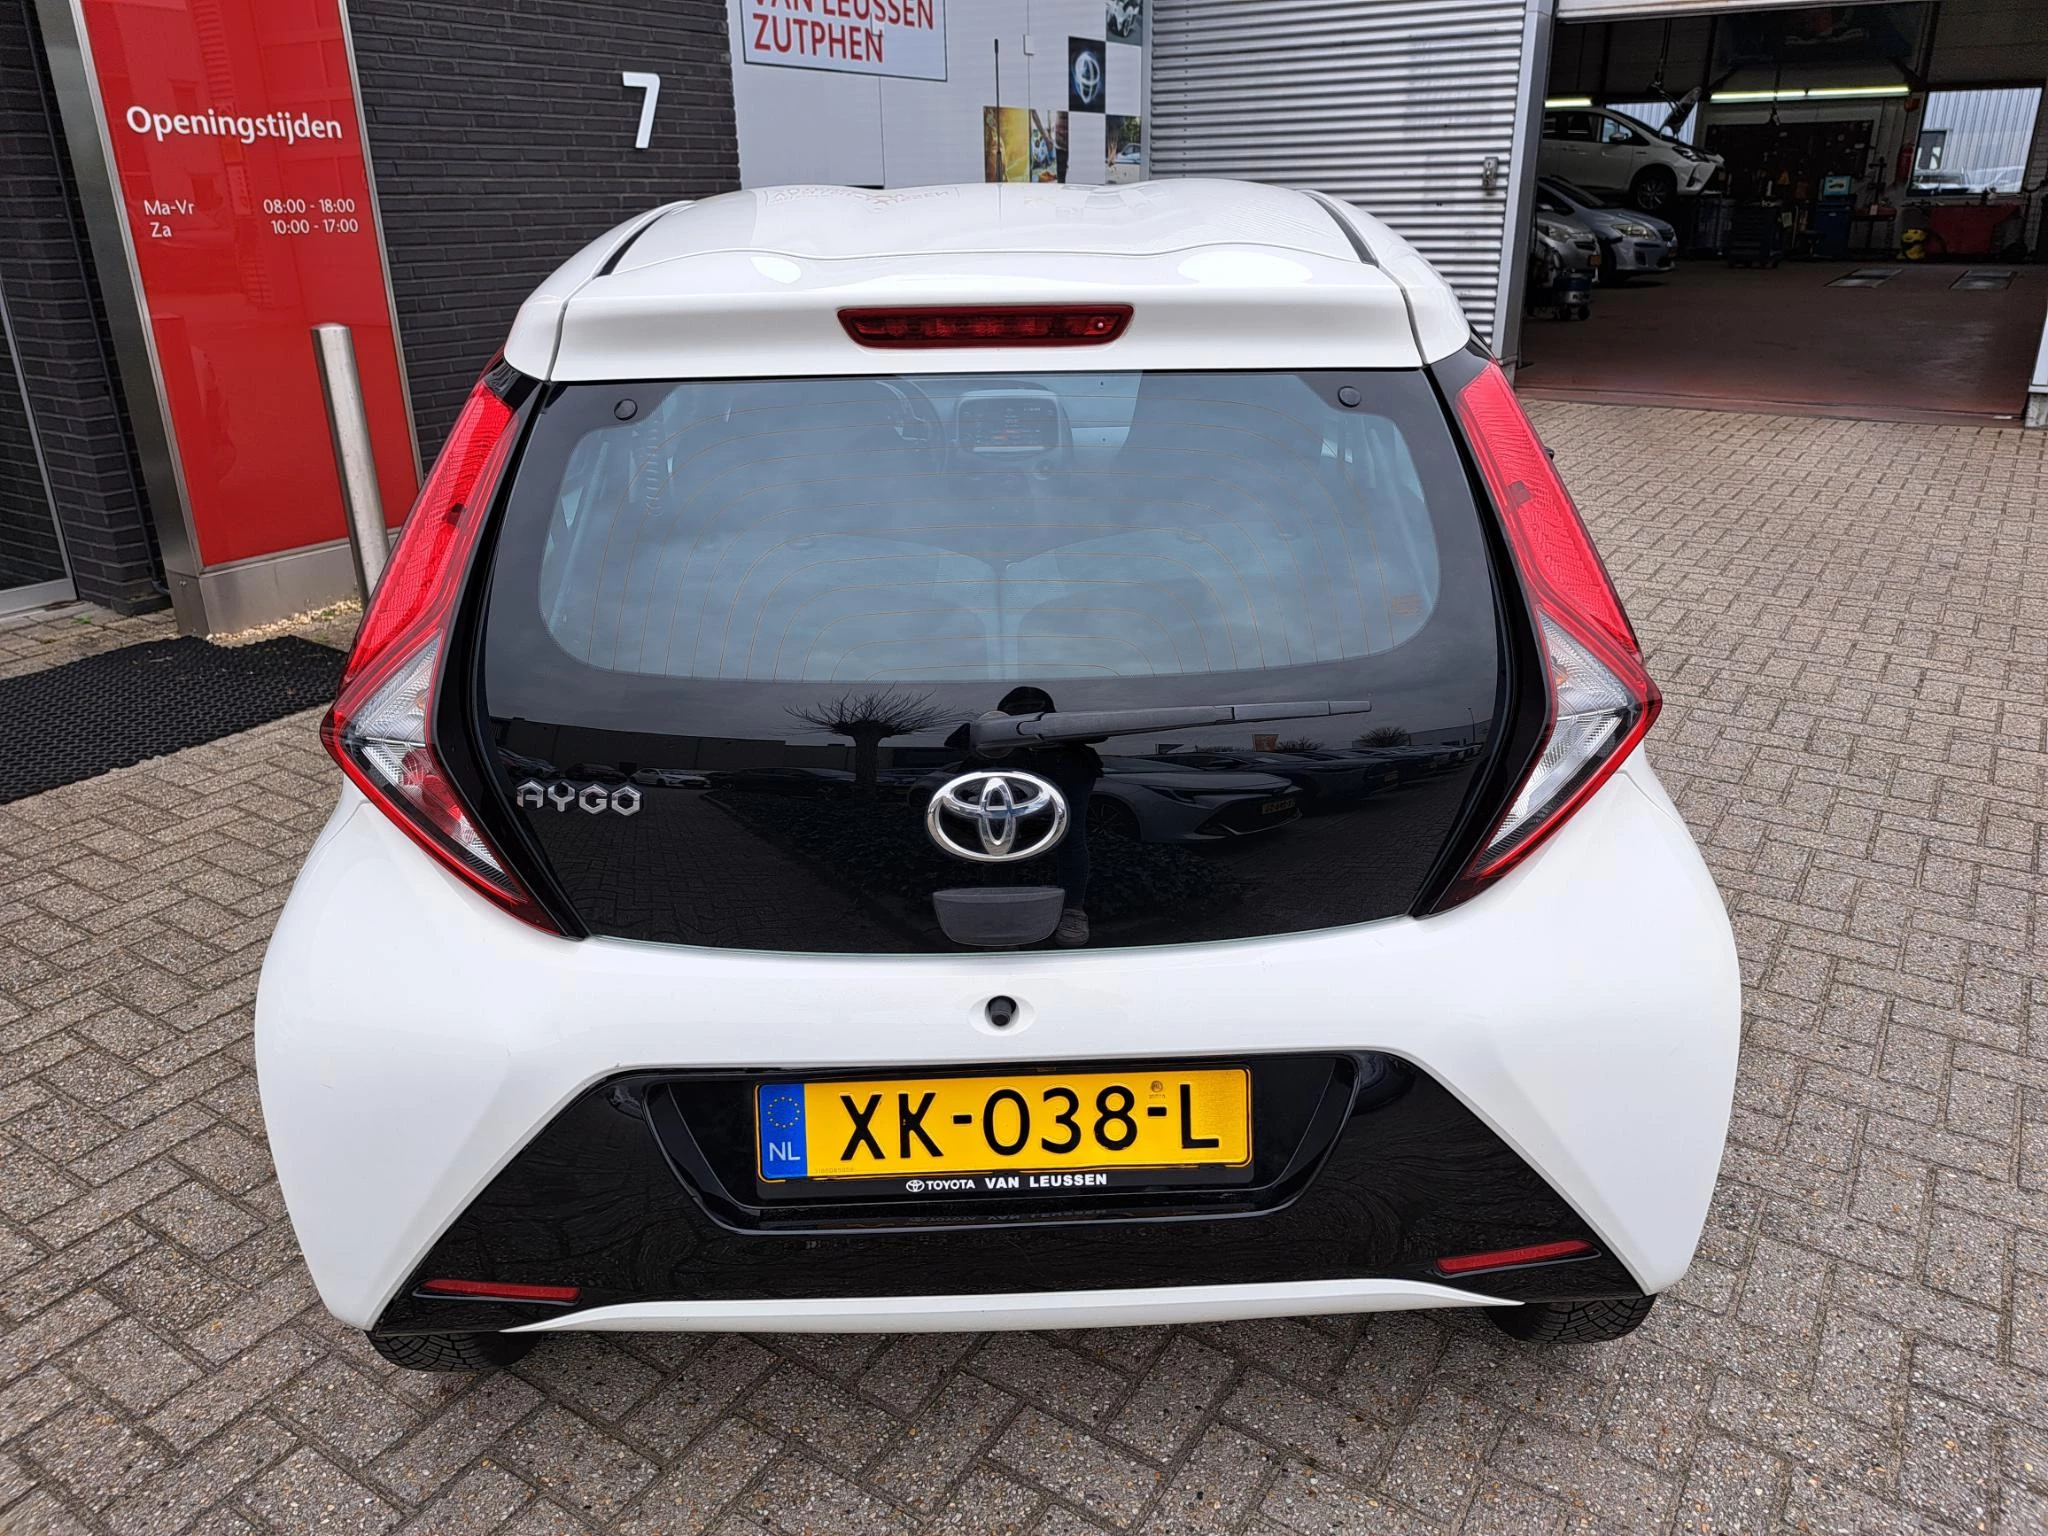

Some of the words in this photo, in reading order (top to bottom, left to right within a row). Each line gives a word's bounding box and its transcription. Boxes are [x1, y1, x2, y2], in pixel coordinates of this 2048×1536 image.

[752, 13, 884, 63] ZUTPHEN
[126, 105, 343, 145] Openingstijden
[622, 71, 661, 149] 7
[143, 199, 195, 216] Ma-Vr
[263, 198, 306, 215] 08:00
[319, 198, 355, 214] 18:00
[150, 221, 172, 238] Za
[271, 218, 310, 235] 10:00
[323, 217, 359, 234] 17:00
[516, 780, 642, 816] AYGO
[840, 1083, 1220, 1161] XK-038-L
[768, 1141, 801, 1162] NL
[926, 1179, 976, 1191] TOYOTA
[985, 1176, 1020, 1189] VAN
[1029, 1173, 1108, 1188] LEUSSEN
